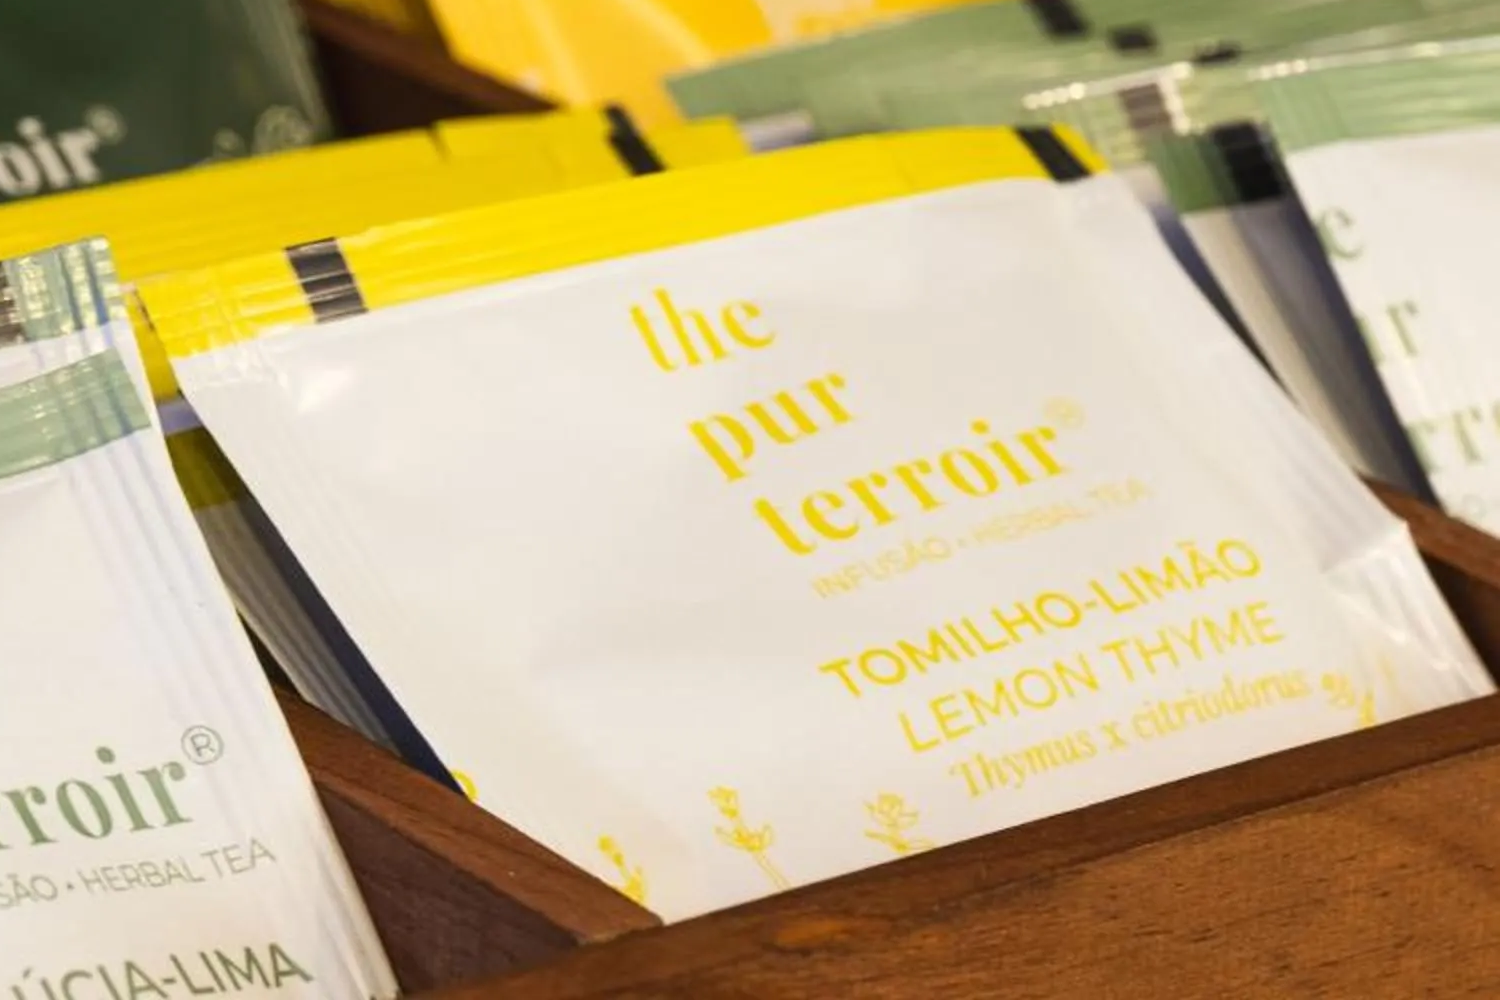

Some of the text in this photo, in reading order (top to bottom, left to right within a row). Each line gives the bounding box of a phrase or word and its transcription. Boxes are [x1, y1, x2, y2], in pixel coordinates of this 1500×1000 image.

[629, 287, 777, 373] the
[687, 370, 856, 482] pur
[810, 535, 952, 600] INFUSÃO
[818, 536, 1263, 698] TOMILHO-LIMÃO
[898, 600, 1285, 754] LEMON THYME
[948, 667, 1312, 798] Thymus x citriodorus
[82, 859, 204, 894] HERBAL
[202, 836, 277, 880] TEA
